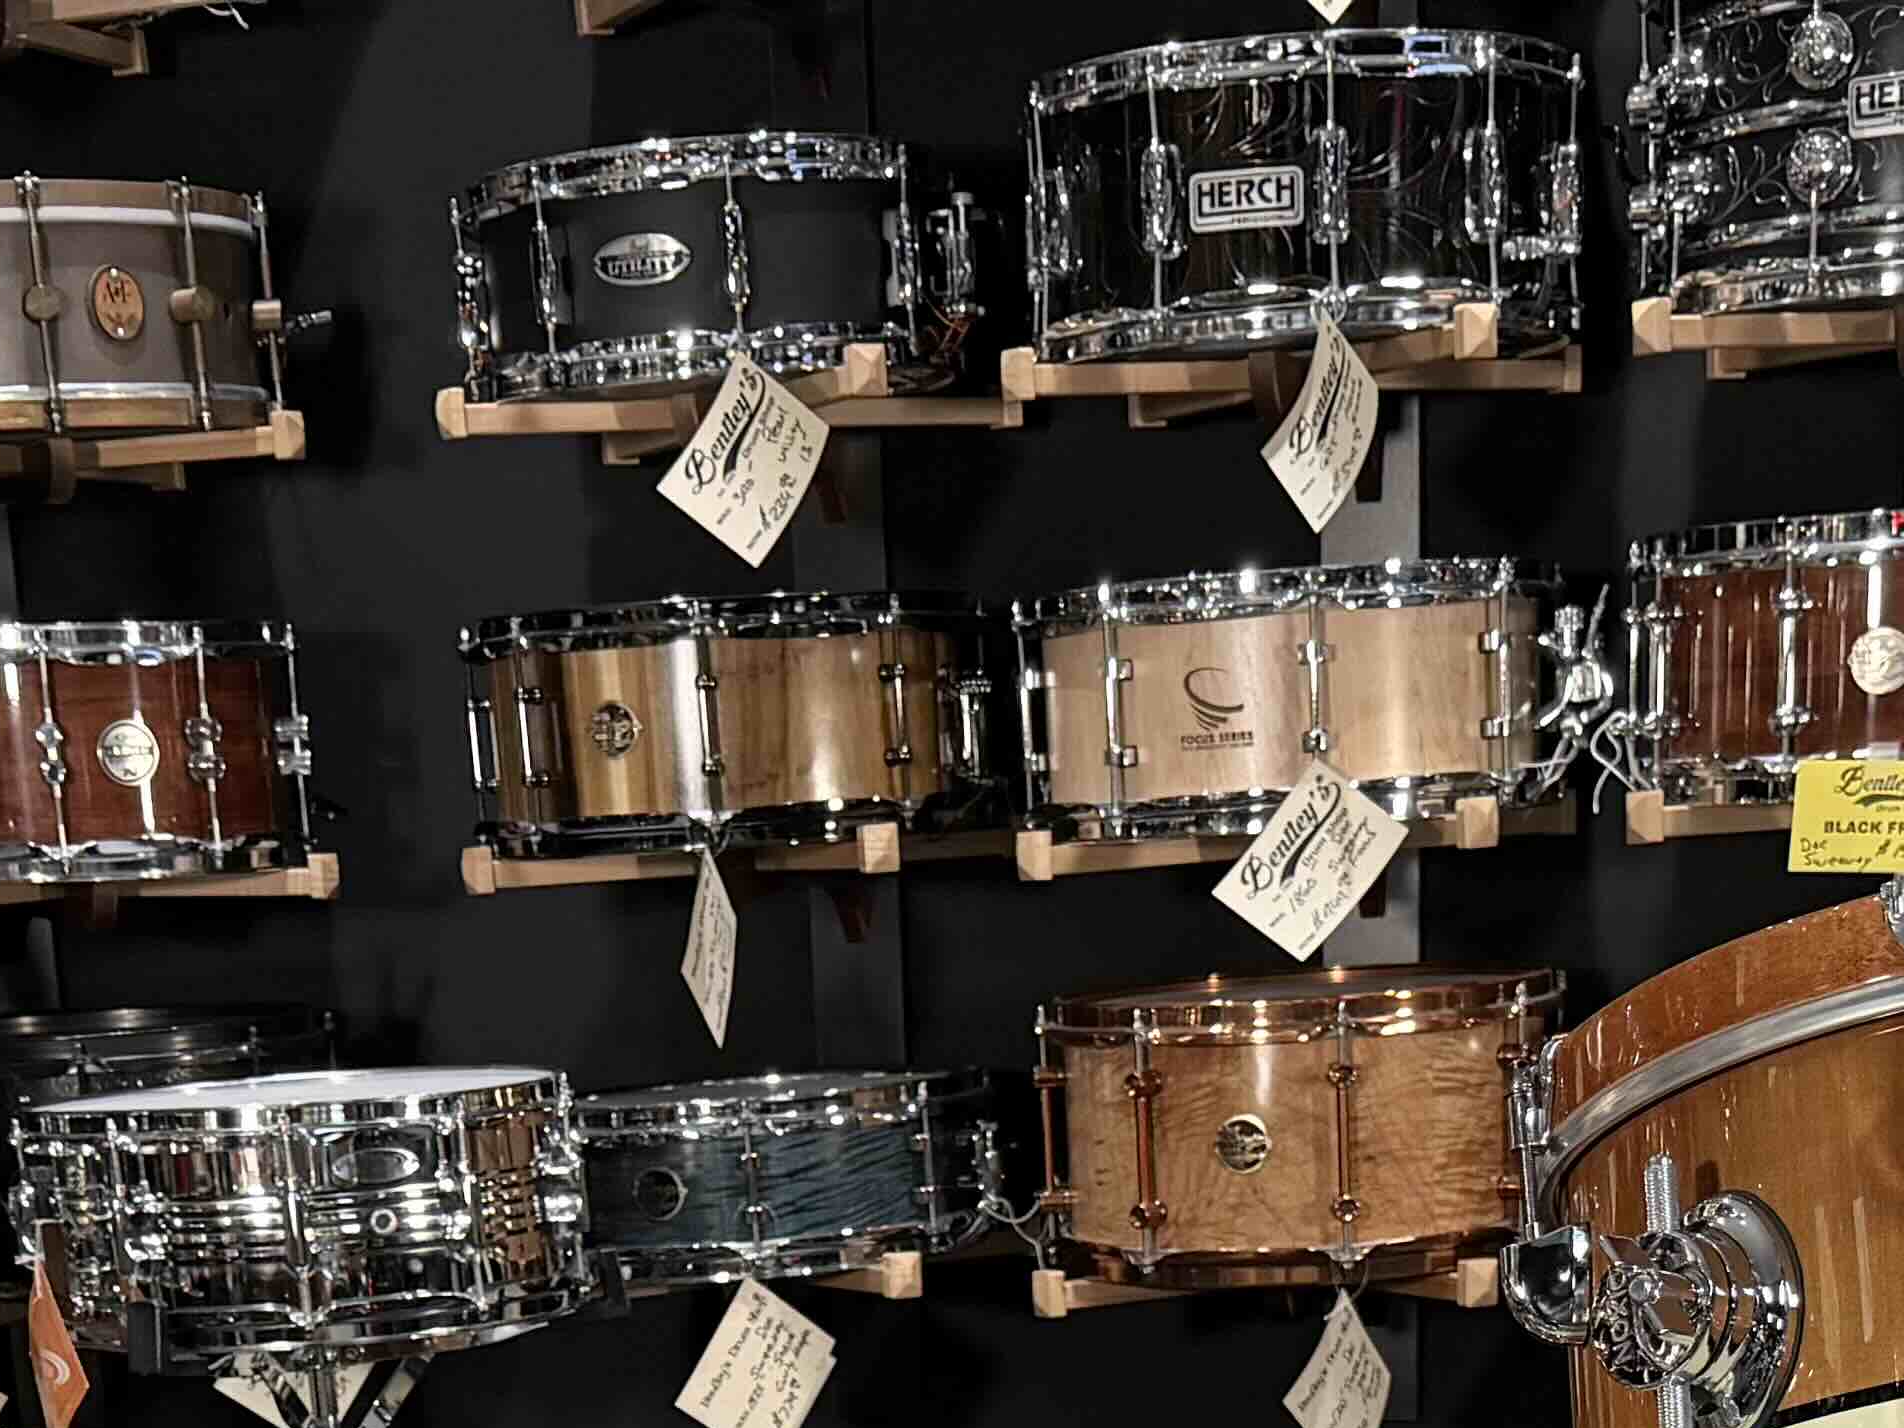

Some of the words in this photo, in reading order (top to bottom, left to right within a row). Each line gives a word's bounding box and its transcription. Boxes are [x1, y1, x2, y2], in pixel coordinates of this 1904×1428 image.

[1197, 175, 1295, 210] HERCH
[685, 370, 766, 495] Bentley's
[1240, 782, 1342, 901] Bentley's
[1824, 820, 1882, 835] BLACK
